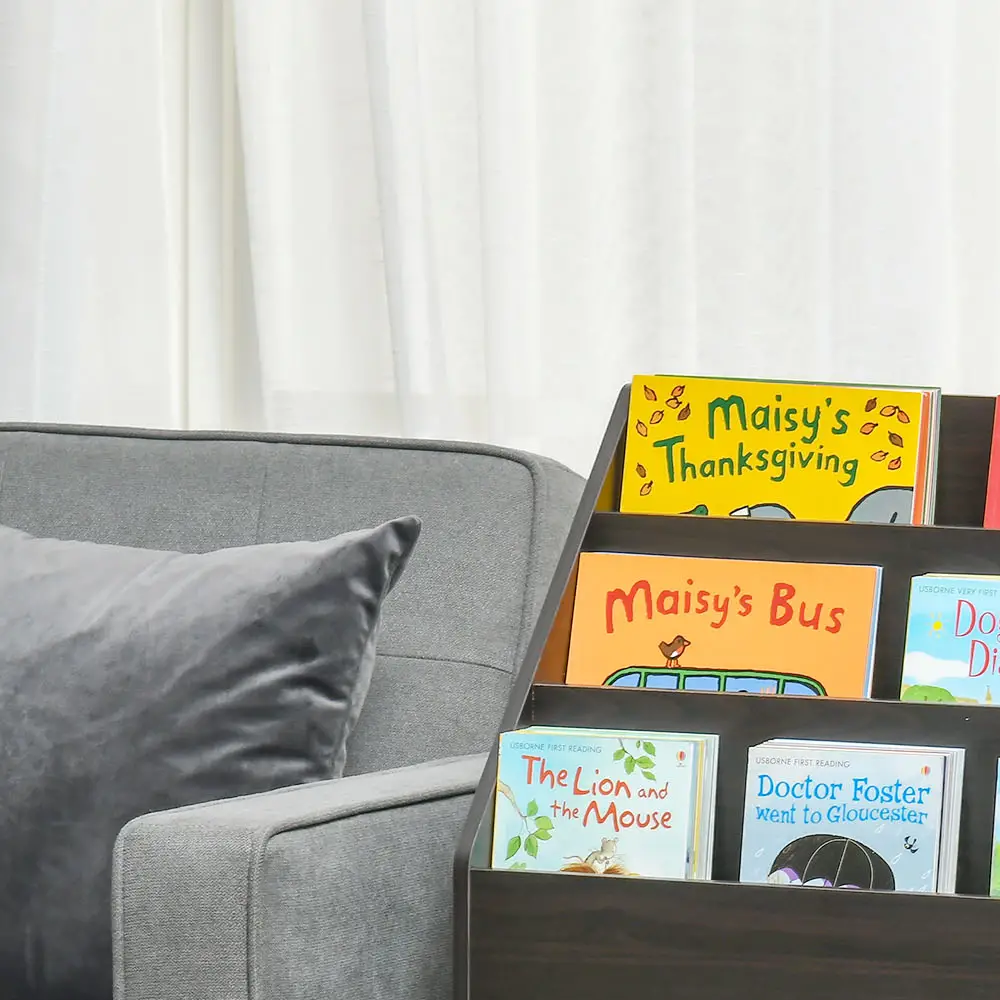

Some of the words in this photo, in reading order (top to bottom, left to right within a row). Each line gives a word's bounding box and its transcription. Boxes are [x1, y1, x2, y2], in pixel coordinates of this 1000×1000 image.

[708, 394, 850, 444] Maisy's
[653, 435, 858, 487] Thanksgiving
[605, 579, 753, 634] Maisy's
[769, 582, 845, 634] Bus
[918, 585, 955, 595] USBORNE
[957, 587, 978, 596] VERY
[978, 588, 998, 598] FIRST
[510, 742, 545, 752] USBORNE
[547, 743, 567, 753] FIRST
[568, 744, 602, 754] READING
[755, 757, 792, 766] USBORNE
[793, 758, 814, 768] FIRST
[816, 759, 850, 769] READING
[521, 754, 568, 790] The
[572, 766, 632, 799] Lion
[638, 781, 669, 800] and
[757, 774, 843, 800] Doctor
[852, 777, 931, 805] Foster
[549, 799, 579, 820] the
[582, 800, 672, 832] Mouse
[755, 803, 797, 824] went
[803, 804, 822, 825] to
[826, 803, 929, 825] Gloucester
